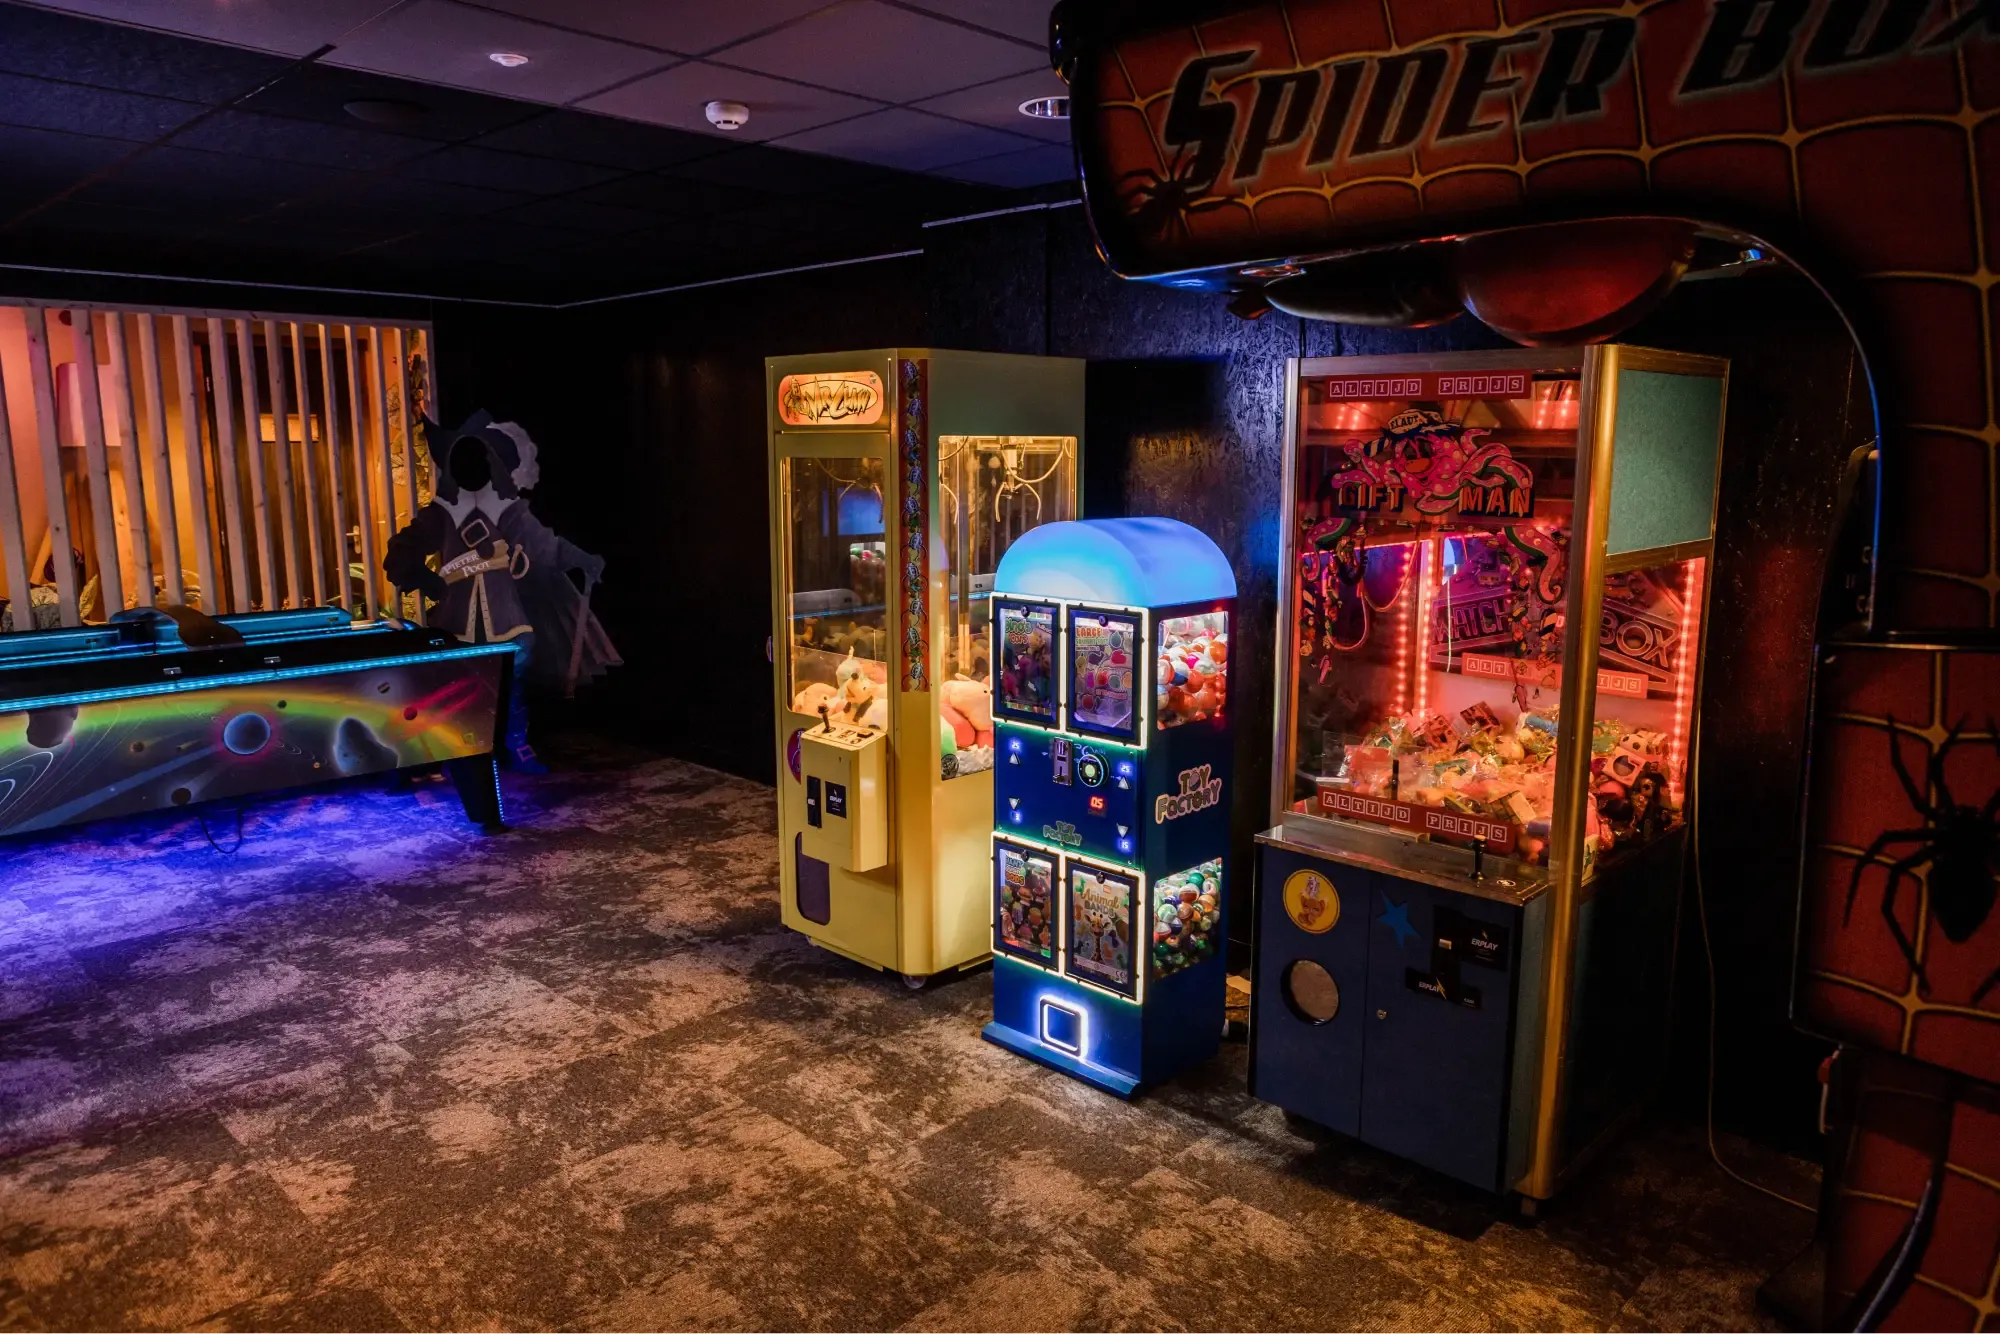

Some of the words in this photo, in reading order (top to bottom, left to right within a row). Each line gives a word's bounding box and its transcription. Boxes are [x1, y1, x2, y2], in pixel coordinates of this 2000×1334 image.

[1163, 16, 1638, 189] SPIDER
[1330, 379, 1422, 397] ALTIJD
[1439, 375, 1525, 394] PRIJS
[1337, 483, 1407, 512] GIFT
[1458, 486, 1534, 517] MAN
[443, 554, 479, 574] PIETER
[461, 560, 490, 577] POOT
[1076, 627, 1101, 637] LARGE
[1178, 764, 1211, 794] TOY
[1323, 791, 1411, 824] ALTIJD
[1426, 813, 1508, 843] PRIJS
[1080, 887, 1120, 909] Animal
[1084, 900, 1116, 917] BANDS
